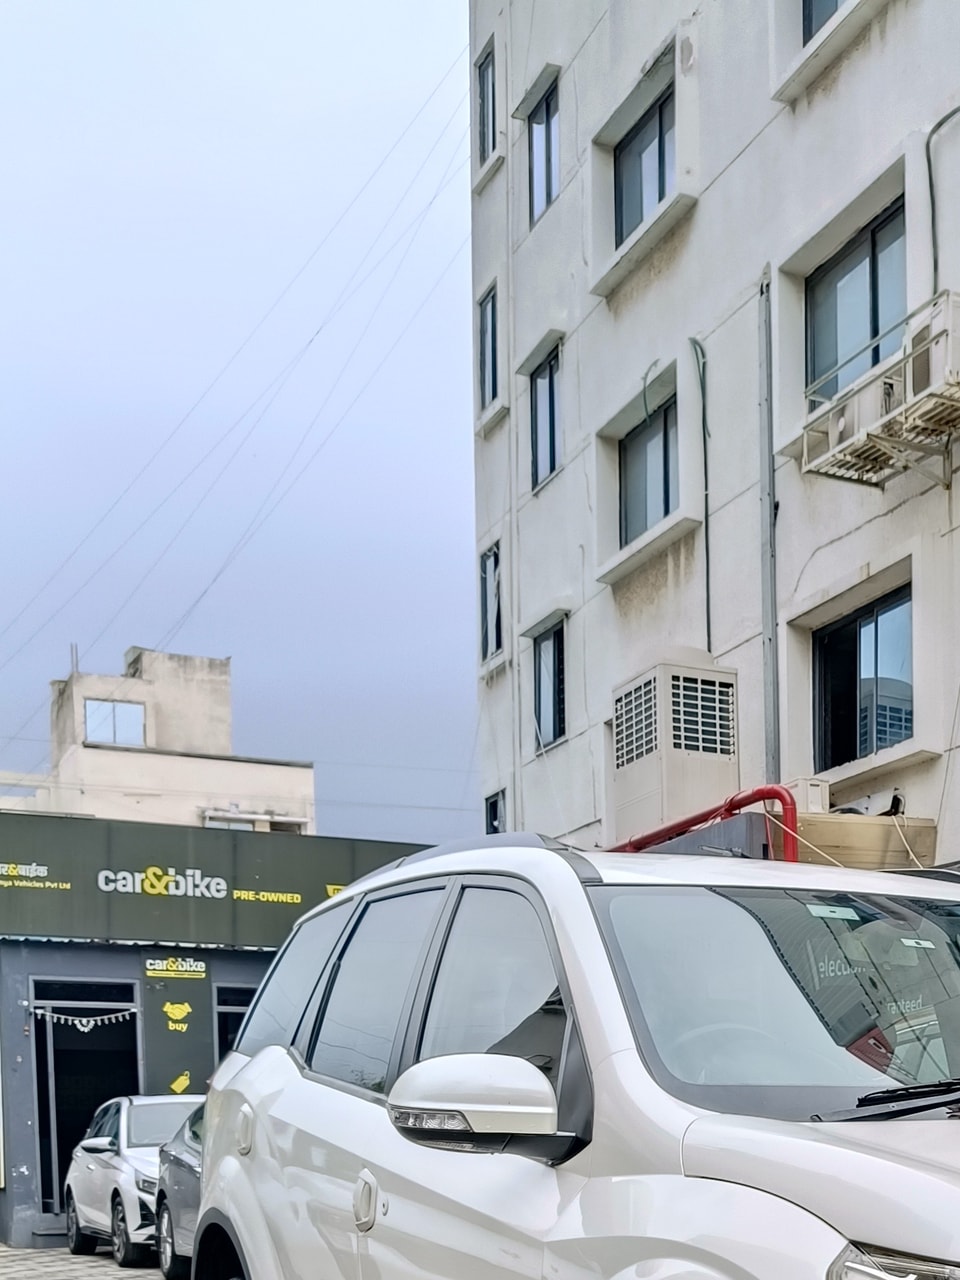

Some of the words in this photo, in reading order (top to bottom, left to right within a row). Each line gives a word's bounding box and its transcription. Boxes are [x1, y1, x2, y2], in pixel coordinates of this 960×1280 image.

[97, 866, 228, 898] car&bike
[232, 889, 302, 904] PRE-OWNED
[145, 957, 207, 972] car&bike
[168, 1020, 189, 1032] buy
